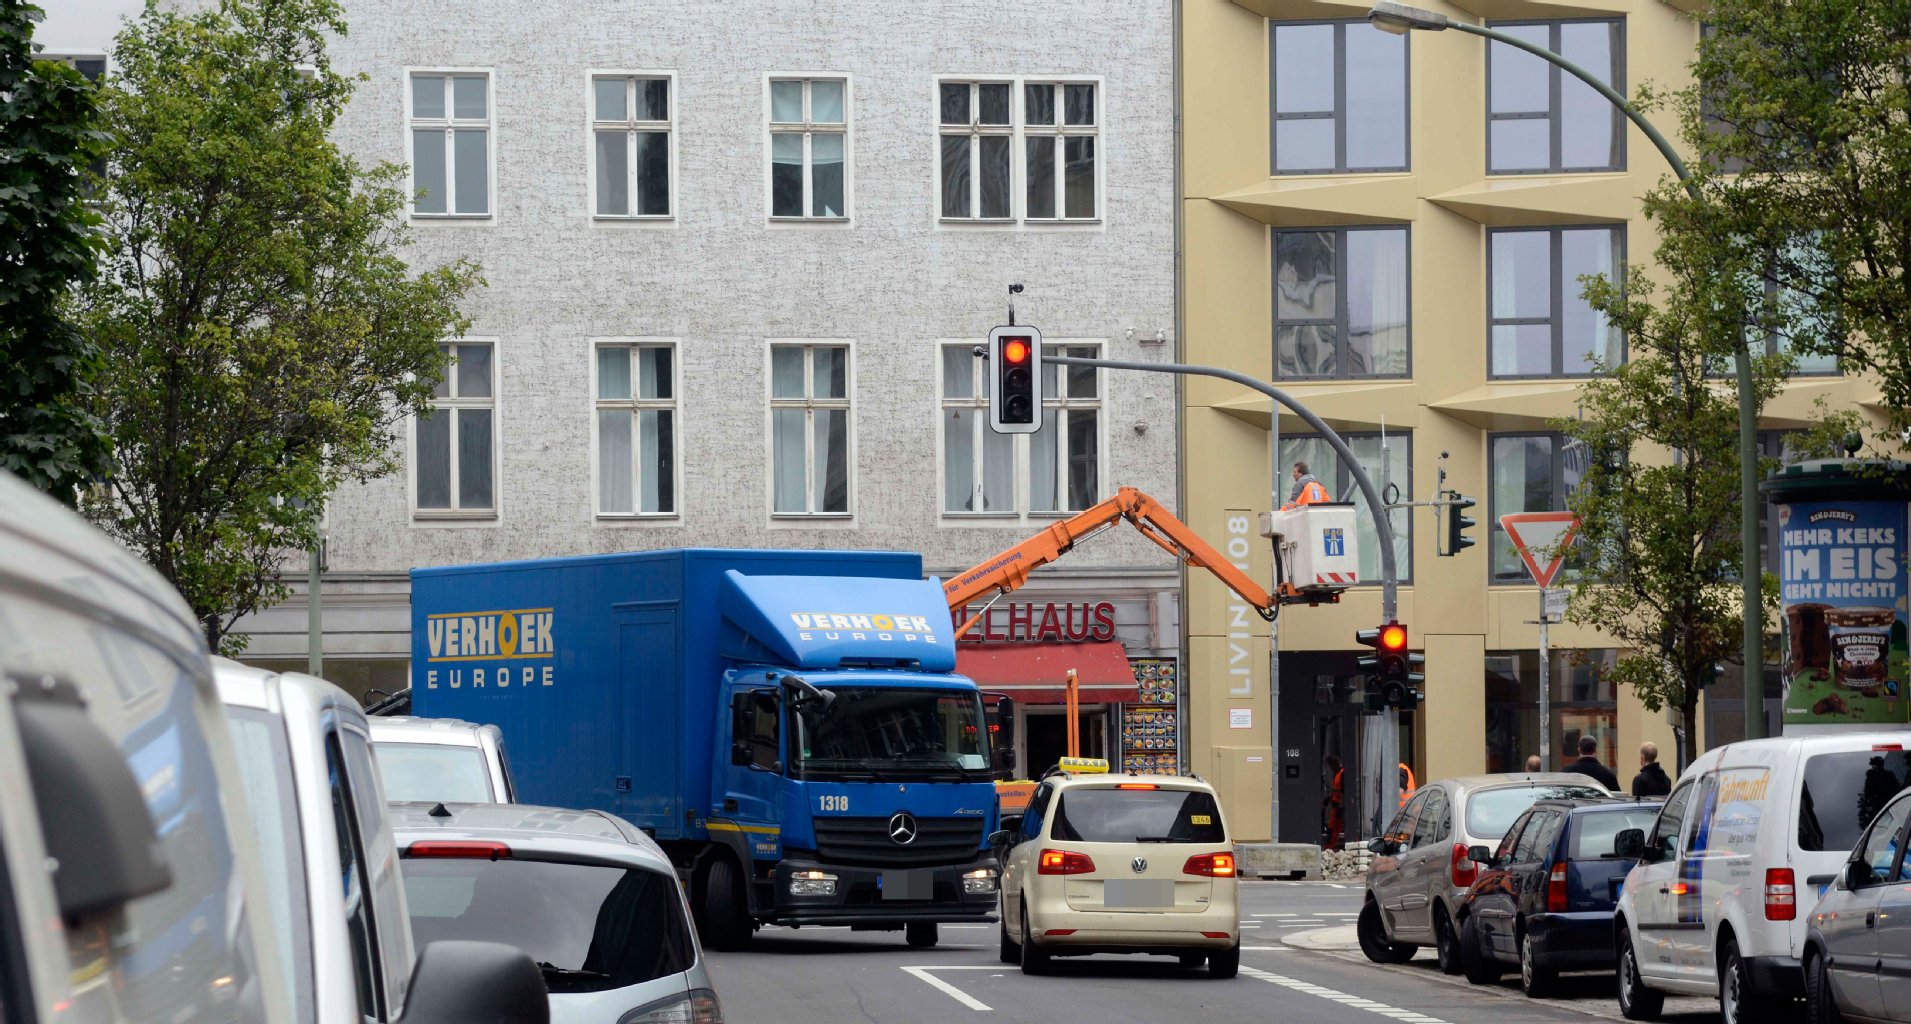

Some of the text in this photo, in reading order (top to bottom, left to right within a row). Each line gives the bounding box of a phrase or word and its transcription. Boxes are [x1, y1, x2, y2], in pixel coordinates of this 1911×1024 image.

[1784, 528, 1896, 547] MEHR KEKS
[961, 552, 1022, 586] Verkehrssicherung
[1784, 547, 1898, 581] IM EIS
[1785, 582, 1896, 600] GEHT NICHT!
[790, 612, 933, 632] VERHOEK
[427, 610, 554, 658] VERHOEK
[800, 632, 937, 644] EUROPE
[427, 666, 554, 689] EUROPE
[1286, 748, 1300, 757] 108
[819, 795, 849, 811] 1318
